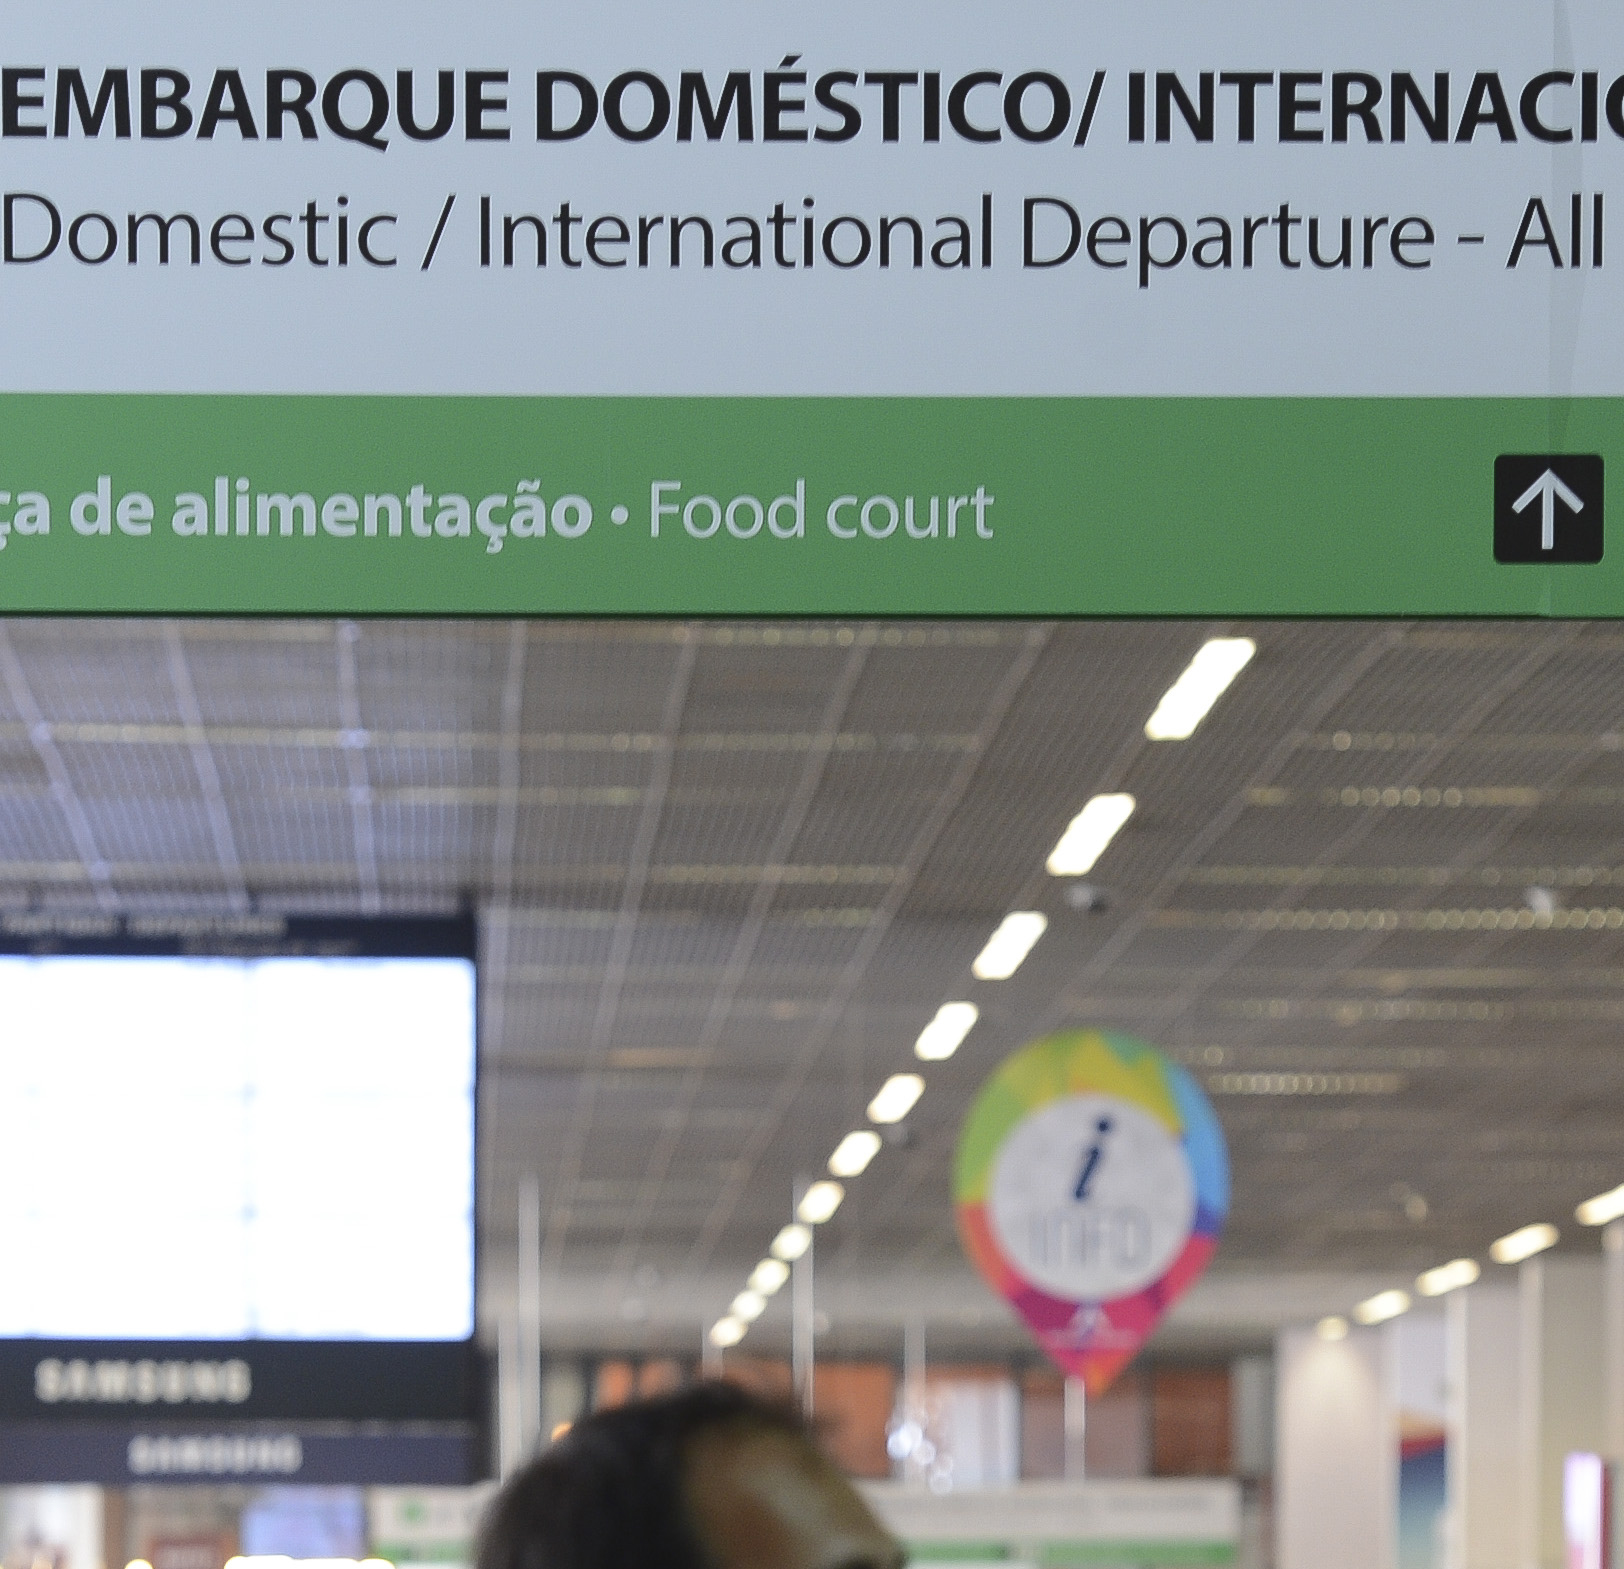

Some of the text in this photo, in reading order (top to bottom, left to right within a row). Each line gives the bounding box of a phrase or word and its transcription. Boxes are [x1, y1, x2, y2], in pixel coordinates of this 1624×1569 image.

[1, 67, 511, 152] EMBARQUE
[3, 193, 398, 267] Domestic
[480, 193, 992, 269] International
[1023, 197, 1435, 289] Departure
[1505, 193, 1604, 269] All
[70, 475, 154, 536] de
[171, 476, 593, 554] alimentação
[650, 479, 805, 539] Food
[826, 486, 995, 539] court
[35, 1358, 252, 1403] SAMSUNG
[128, 1434, 303, 1474] SAMSUNG
